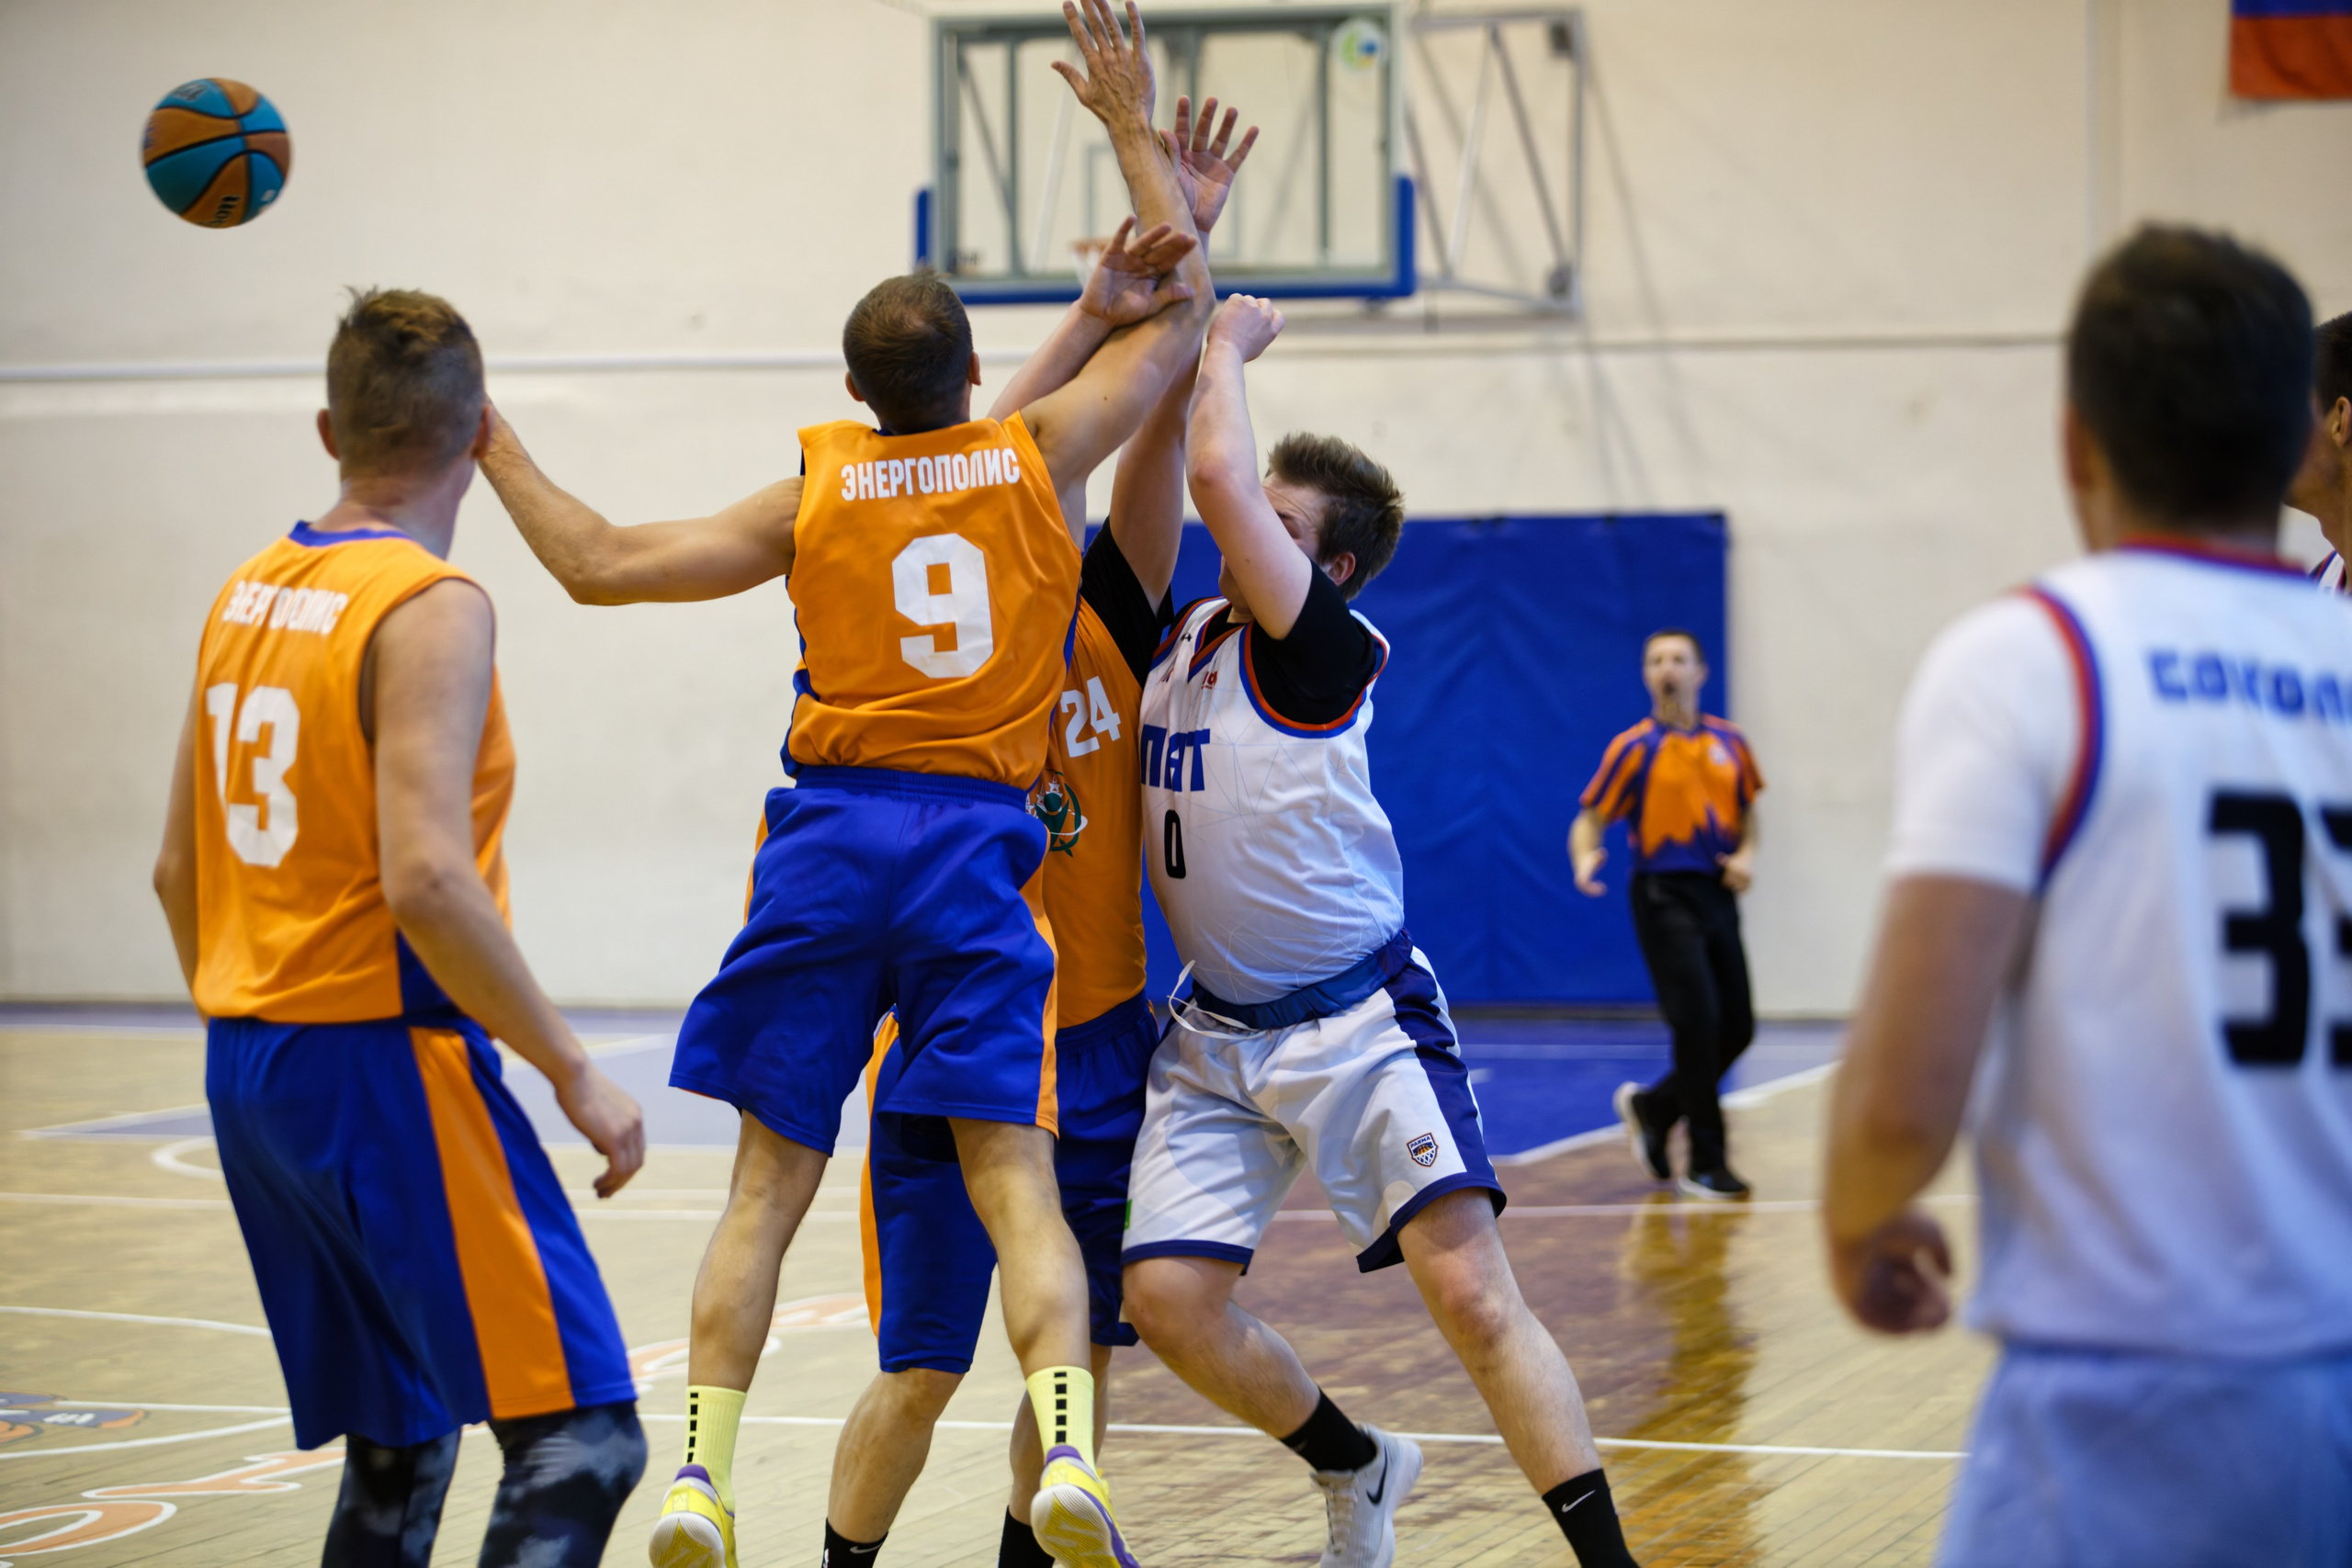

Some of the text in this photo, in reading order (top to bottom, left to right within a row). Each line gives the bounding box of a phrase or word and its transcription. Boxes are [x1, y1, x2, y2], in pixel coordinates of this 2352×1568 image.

[841, 448, 1021, 502] ЭНЕРГОПОЛИС
[891, 533, 994, 679] 9
[1060, 675, 1121, 758] 24
[2148, 648, 2352, 726] СОКОЛ
[206, 682, 301, 868] 13
[1164, 809, 1187, 879] 0
[1409, 1135, 1431, 1148] PARMA
